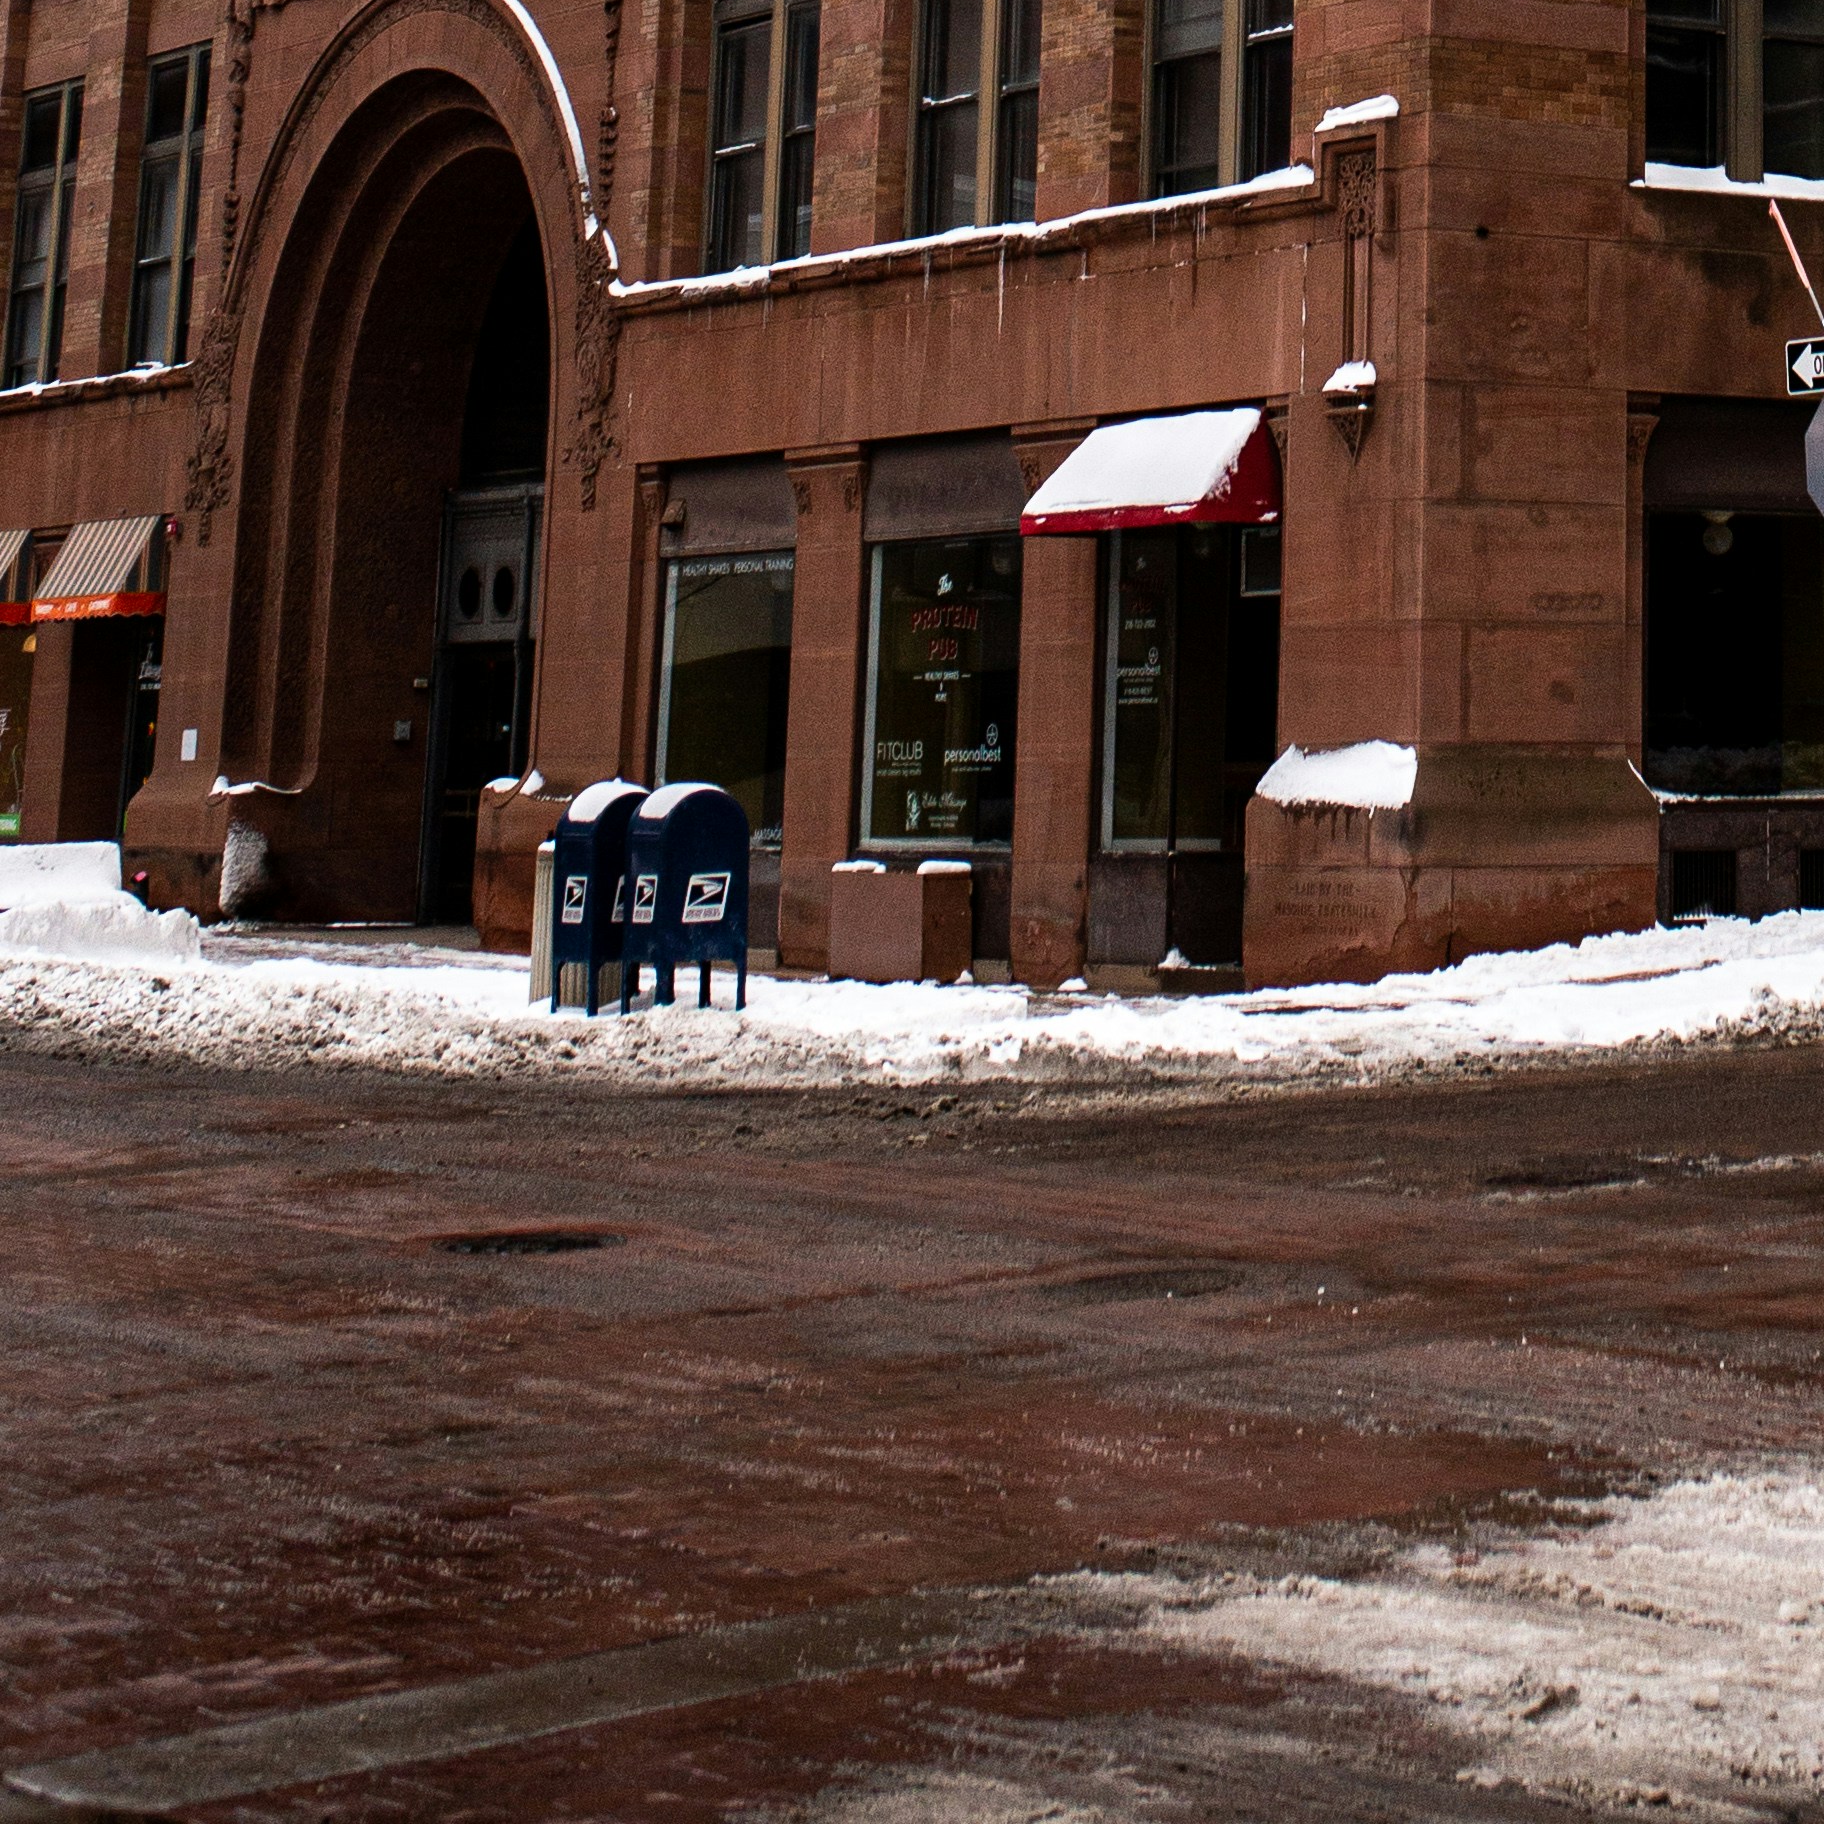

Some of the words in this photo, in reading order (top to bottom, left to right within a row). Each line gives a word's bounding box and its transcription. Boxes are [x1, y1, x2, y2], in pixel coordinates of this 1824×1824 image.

[911, 604, 979, 633] PROTEIN
[928, 637, 959, 661] PUB
[876, 740, 924, 761] FITCLUB
[944, 743, 1002, 767] personalbest
